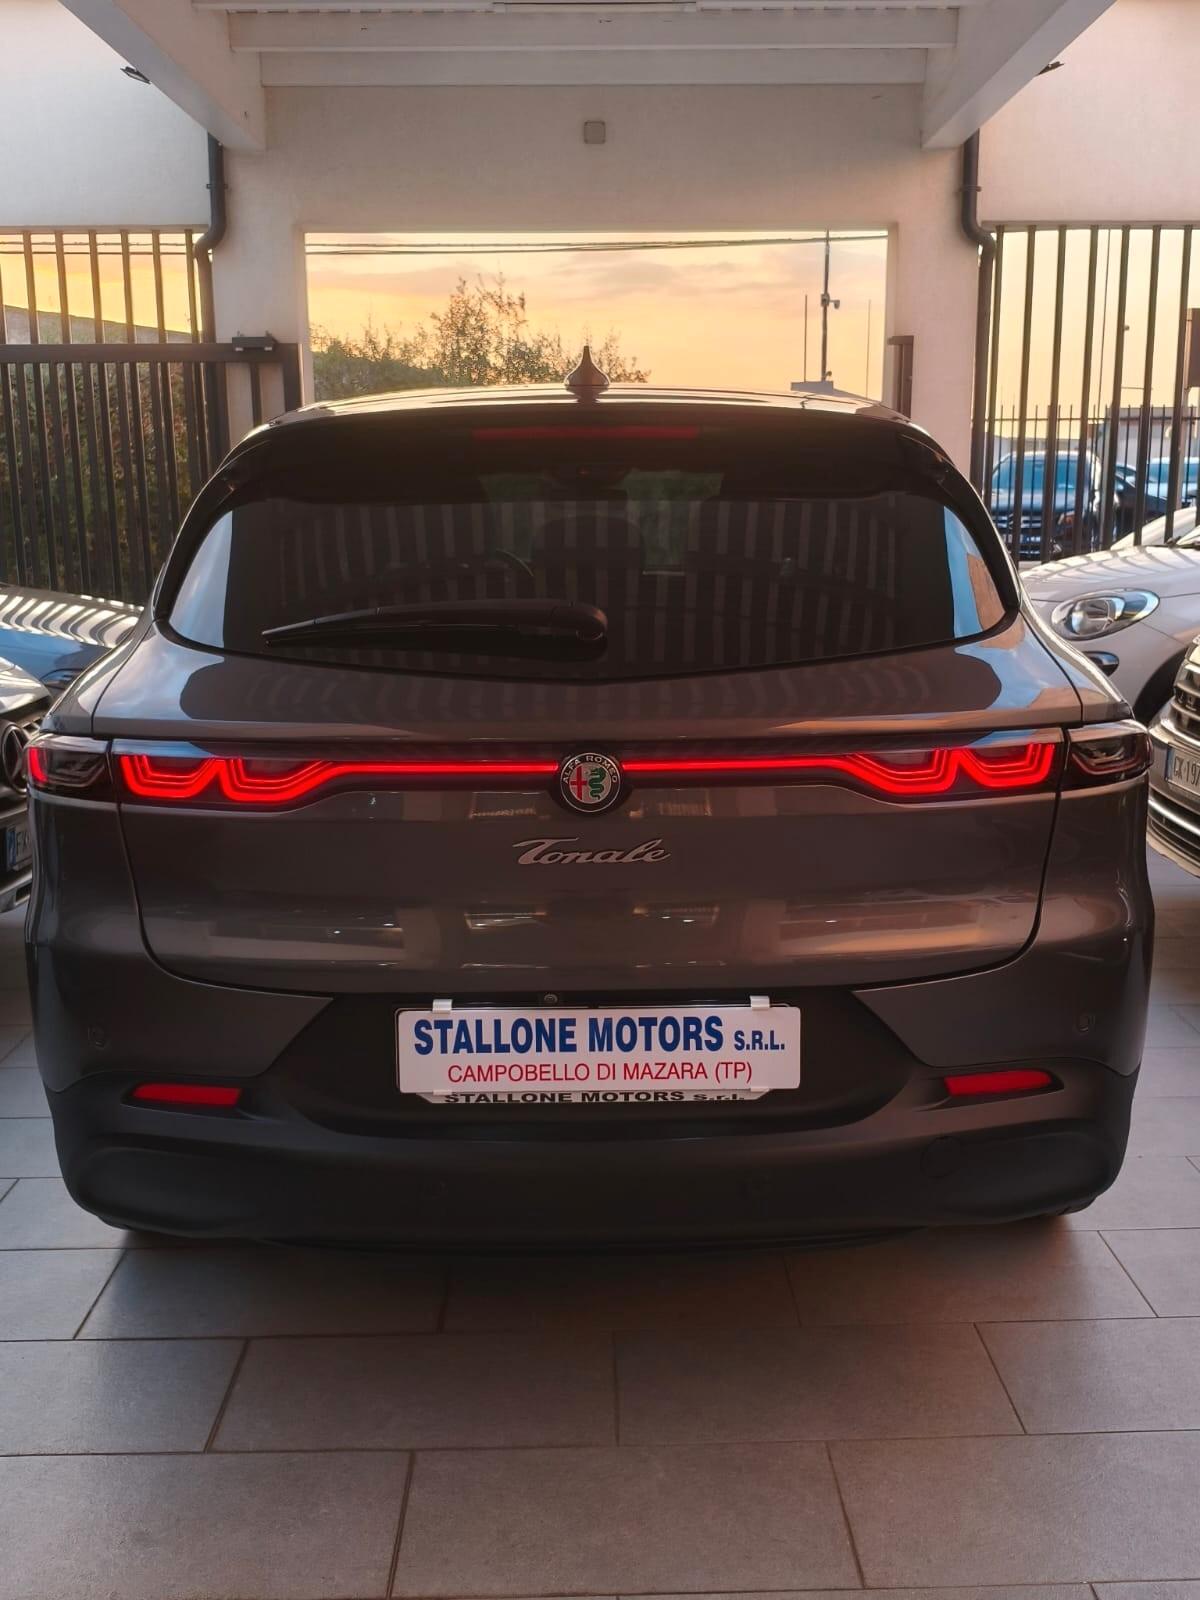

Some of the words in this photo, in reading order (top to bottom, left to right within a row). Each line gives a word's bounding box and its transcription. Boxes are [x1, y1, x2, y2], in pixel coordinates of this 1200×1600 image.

[563, 759, 581, 784] ALFA
[586, 755, 618, 783] ROMEO
[512, 837, 671, 865] Tonale
[414, 1018, 577, 1055] STALLONE
[588, 1016, 724, 1053] MOTORS
[734, 1030, 785, 1050] S.R.L.
[448, 1063, 590, 1082] CAMPOBELLO
[597, 1063, 616, 1080] DI
[623, 1062, 708, 1080] MAZARA
[715, 1061, 752, 1083] (TP)
[444, 1092, 572, 1103] STALLONE
[581, 1091, 685, 1102] MOTORS
